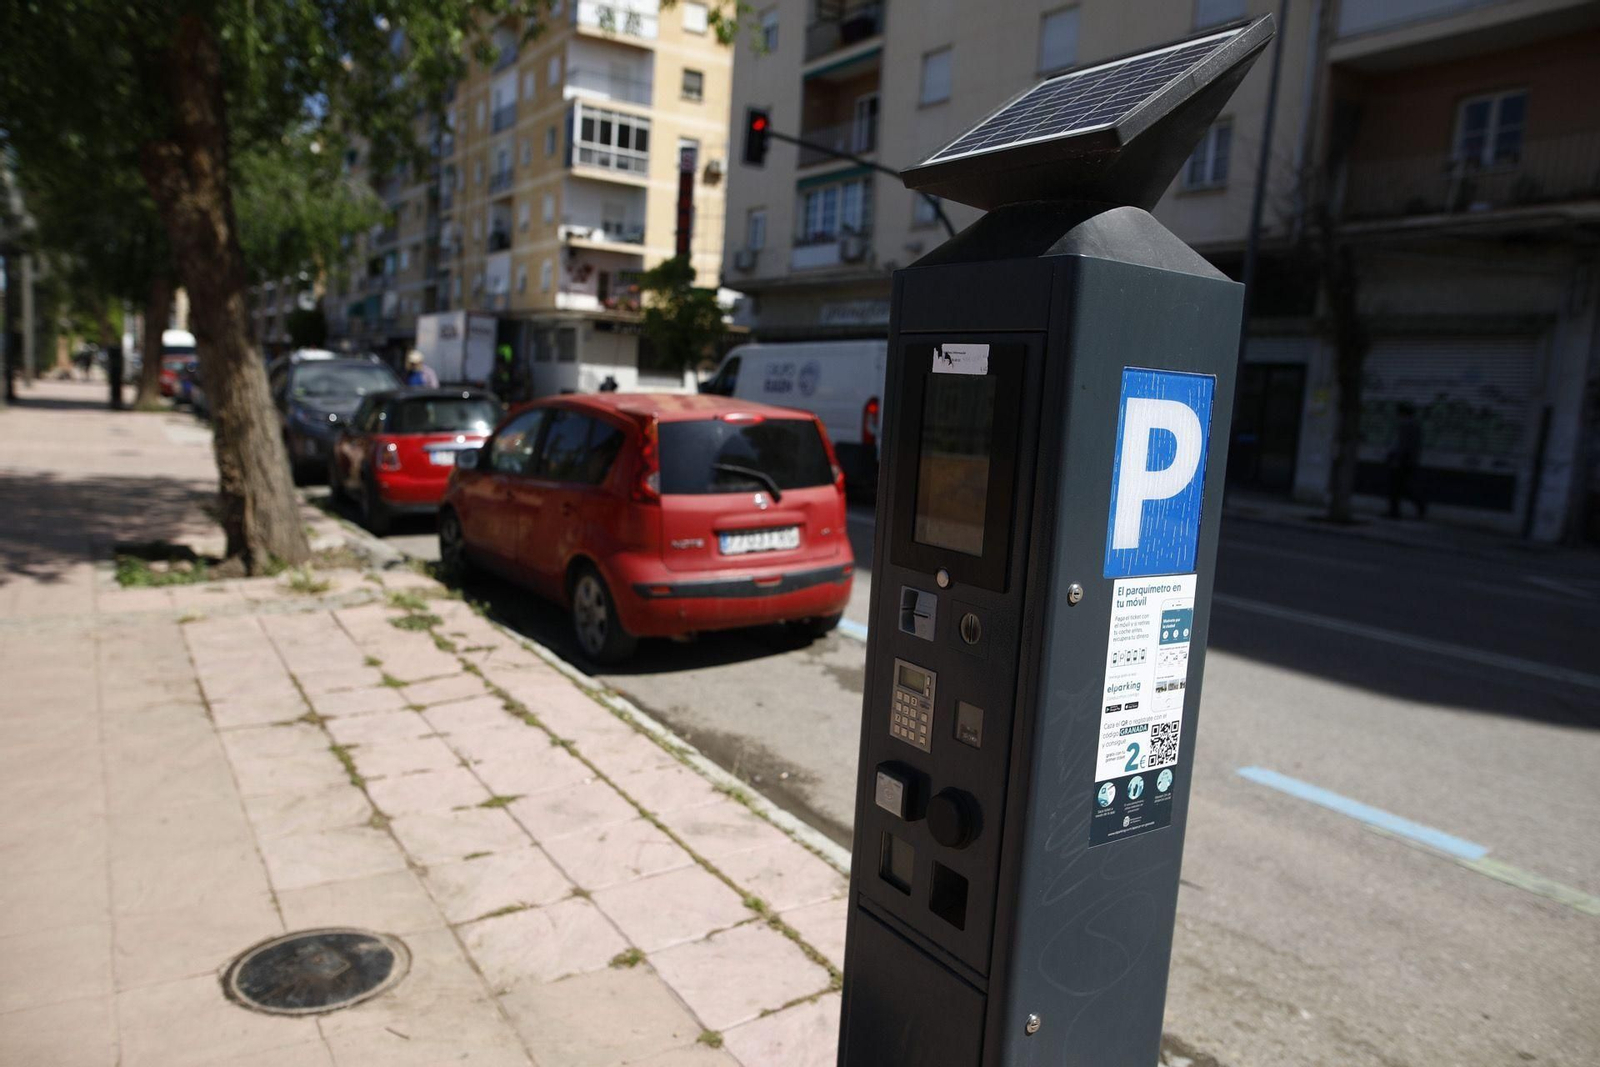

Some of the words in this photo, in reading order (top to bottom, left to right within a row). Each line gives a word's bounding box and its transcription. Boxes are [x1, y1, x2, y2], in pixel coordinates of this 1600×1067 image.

[1112, 397, 1203, 550] P
[1117, 587, 1124, 596] El
[1126, 584, 1171, 597] parquímetro
[1172, 584, 1182, 592] en
[1116, 600, 1124, 608] tu
[1126, 597, 1147, 607] móvil
[1106, 681, 1141, 695] elparking
[1120, 724, 1147, 736] GRANADA
[1105, 739, 1126, 748] consigue
